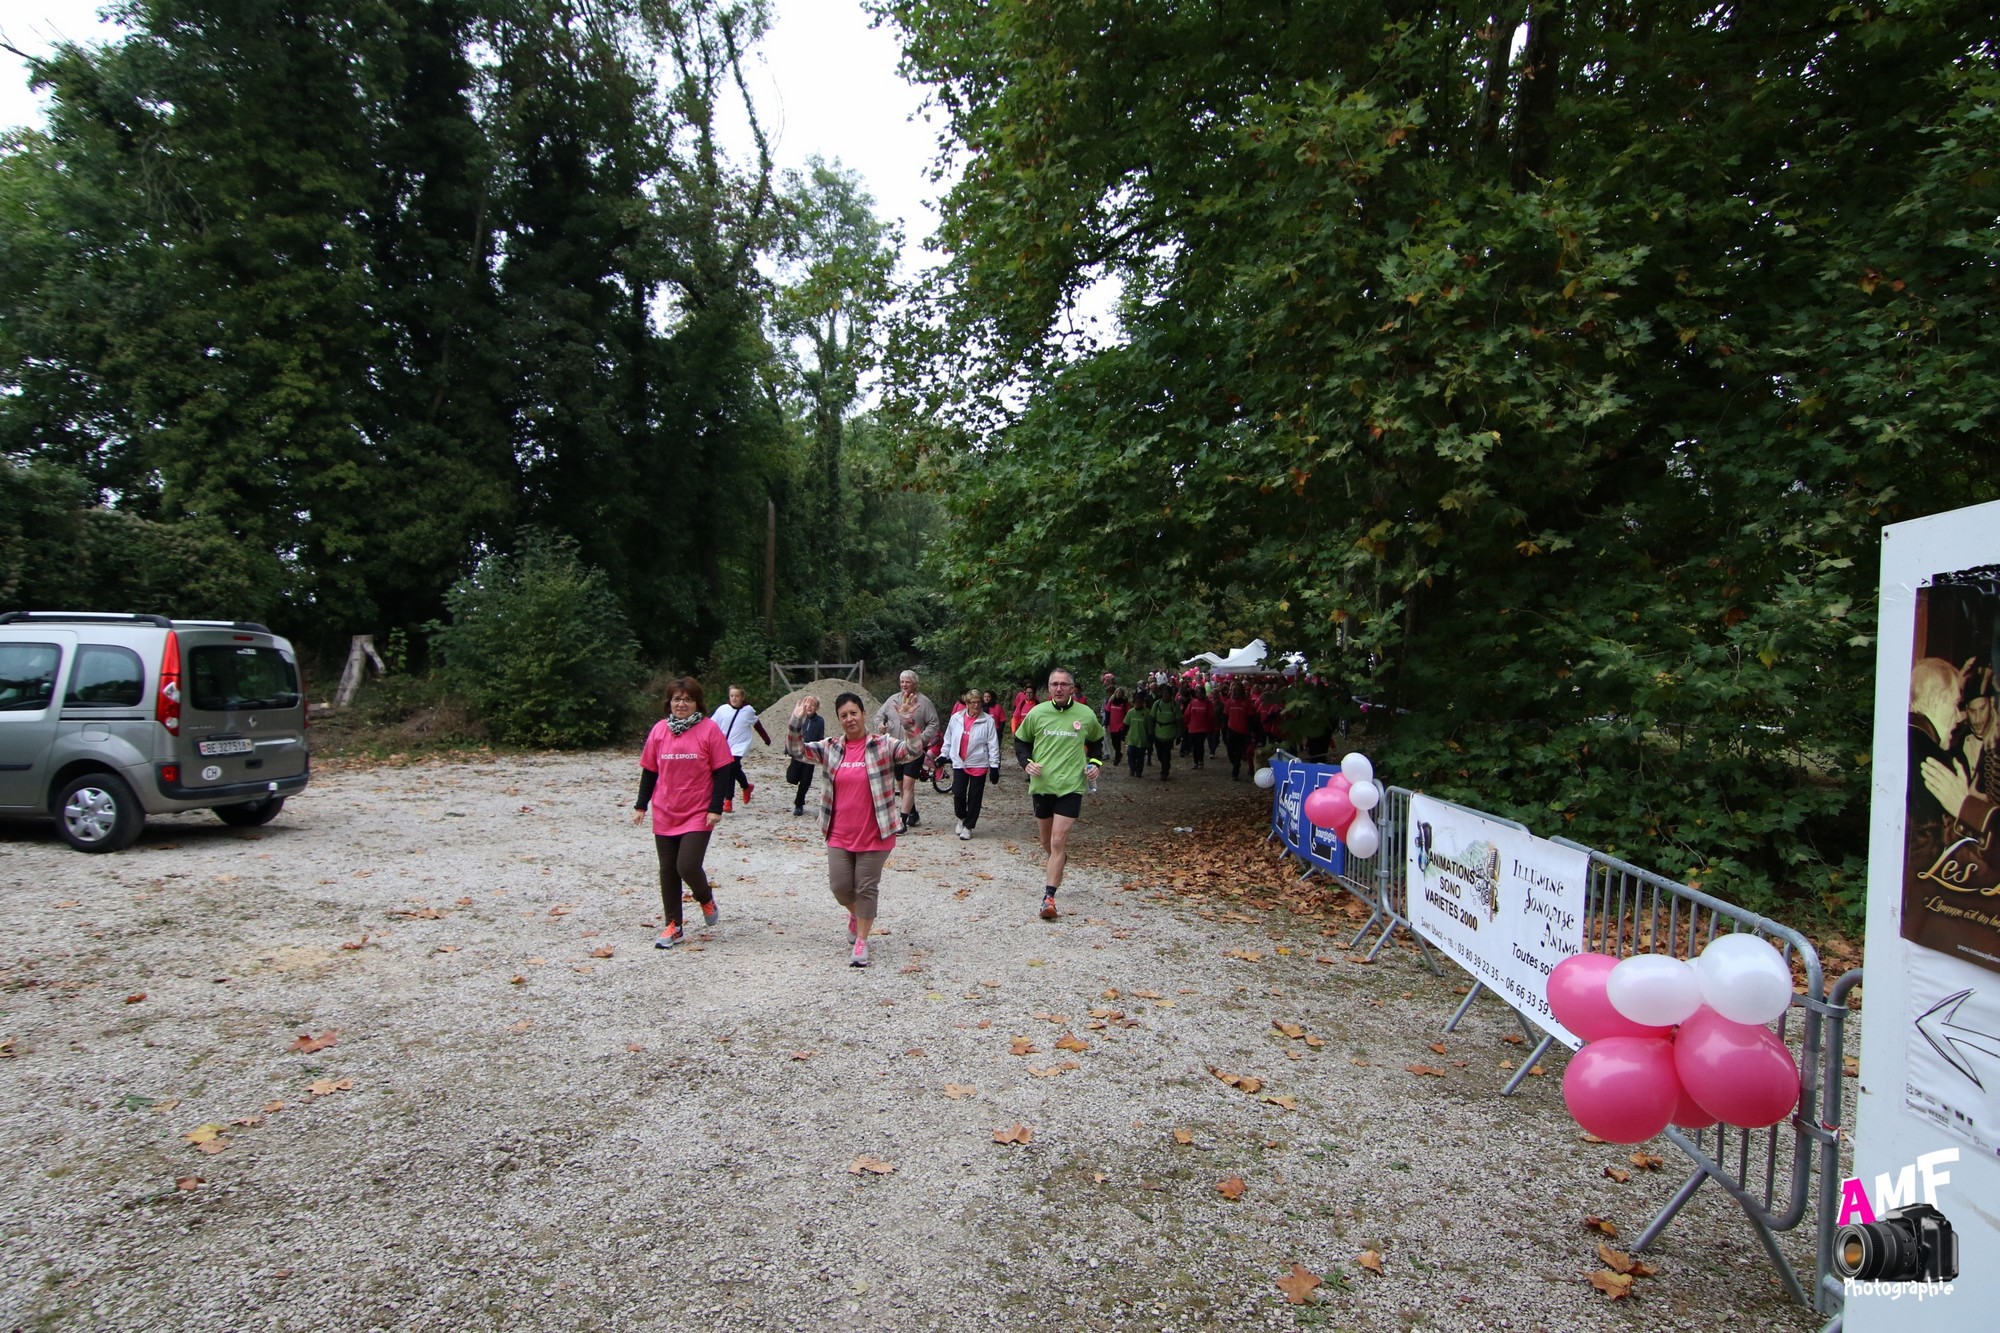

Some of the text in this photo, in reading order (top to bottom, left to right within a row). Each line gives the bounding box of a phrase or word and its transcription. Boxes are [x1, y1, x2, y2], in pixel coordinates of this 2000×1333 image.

[206, 767, 218, 779] CH
[1428, 850, 1476, 886] ANIMATIONS
[1917, 837, 1980, 893] Les
[1439, 876, 1461, 899] SONO
[1425, 886, 1478, 932] VARIETES 2000
[1512, 942, 1554, 976] Toutes soi
[1457, 943, 1465, 956] 03
[1465, 948, 1473, 962] 80
[1473, 954, 1481, 968] 39
[1481, 960, 1490, 975] 22
[1490, 966, 1499, 981] 35
[1505, 977, 1515, 992] 06
[1515, 984, 1525, 999] 66
[1526, 991, 1537, 1007] 33
[1537, 999, 1549, 1015] 59
